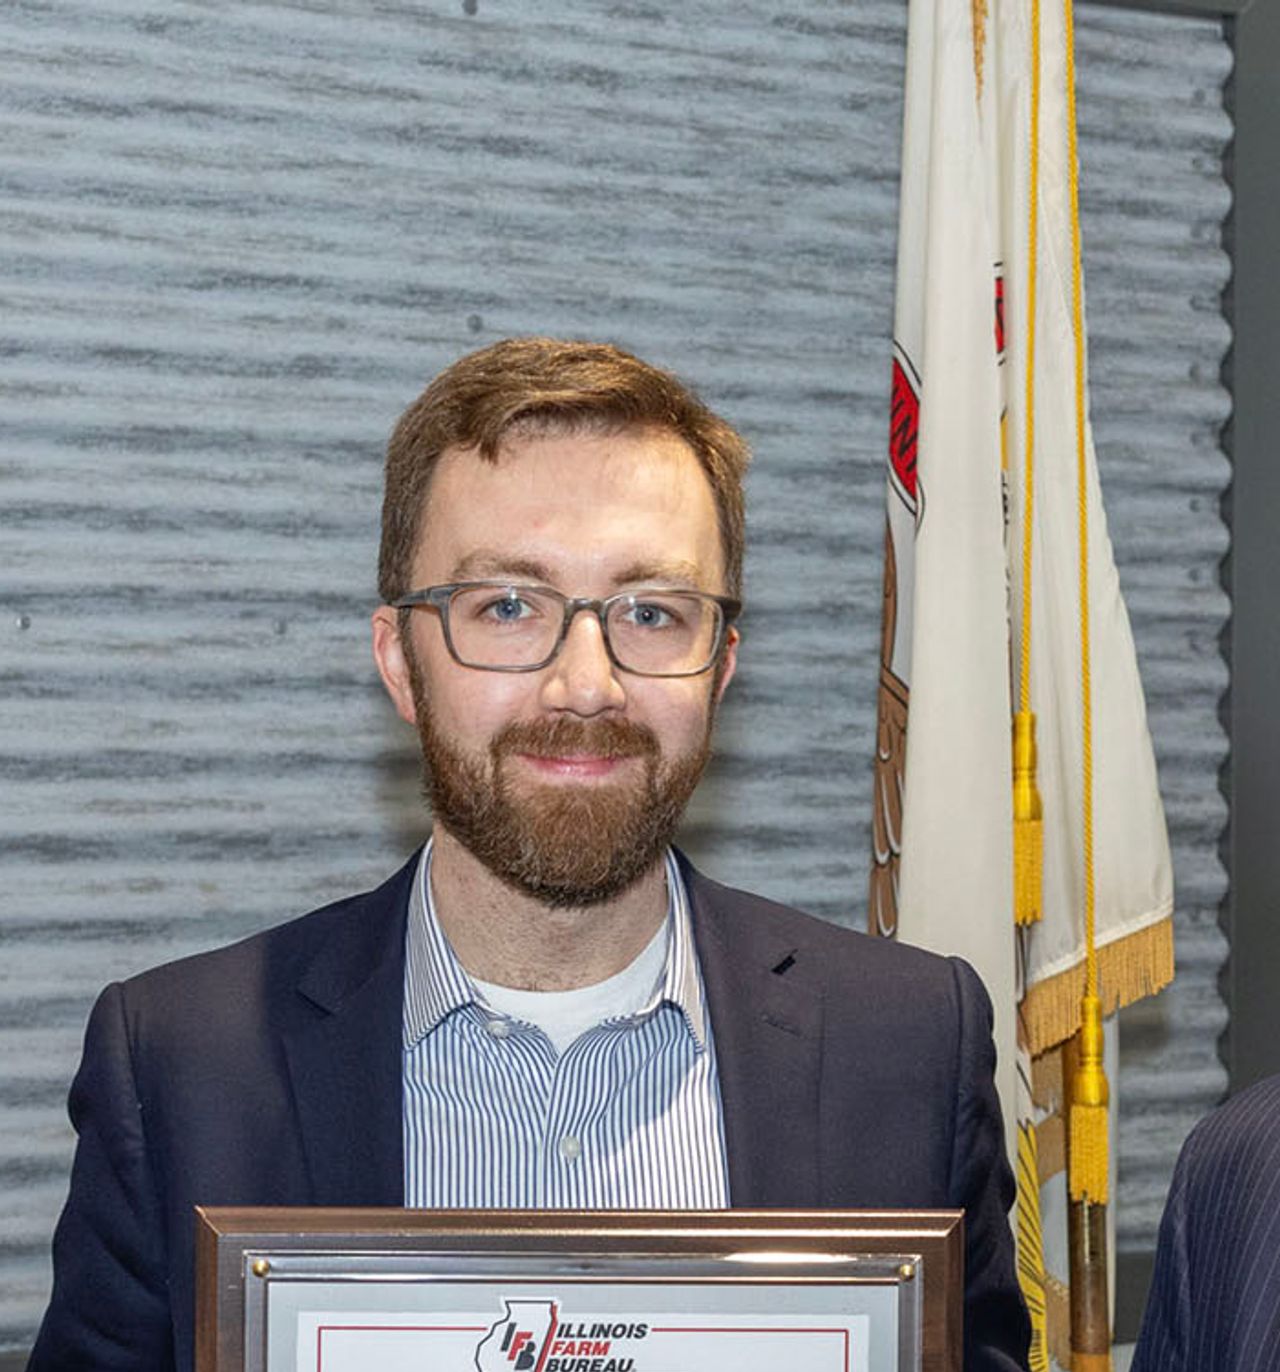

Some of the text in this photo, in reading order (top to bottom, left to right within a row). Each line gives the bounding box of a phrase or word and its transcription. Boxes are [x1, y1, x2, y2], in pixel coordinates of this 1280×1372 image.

[556, 1323, 649, 1339] ILLINOIS
[500, 1322, 536, 1371] IFB
[550, 1341, 611, 1356] FARM
